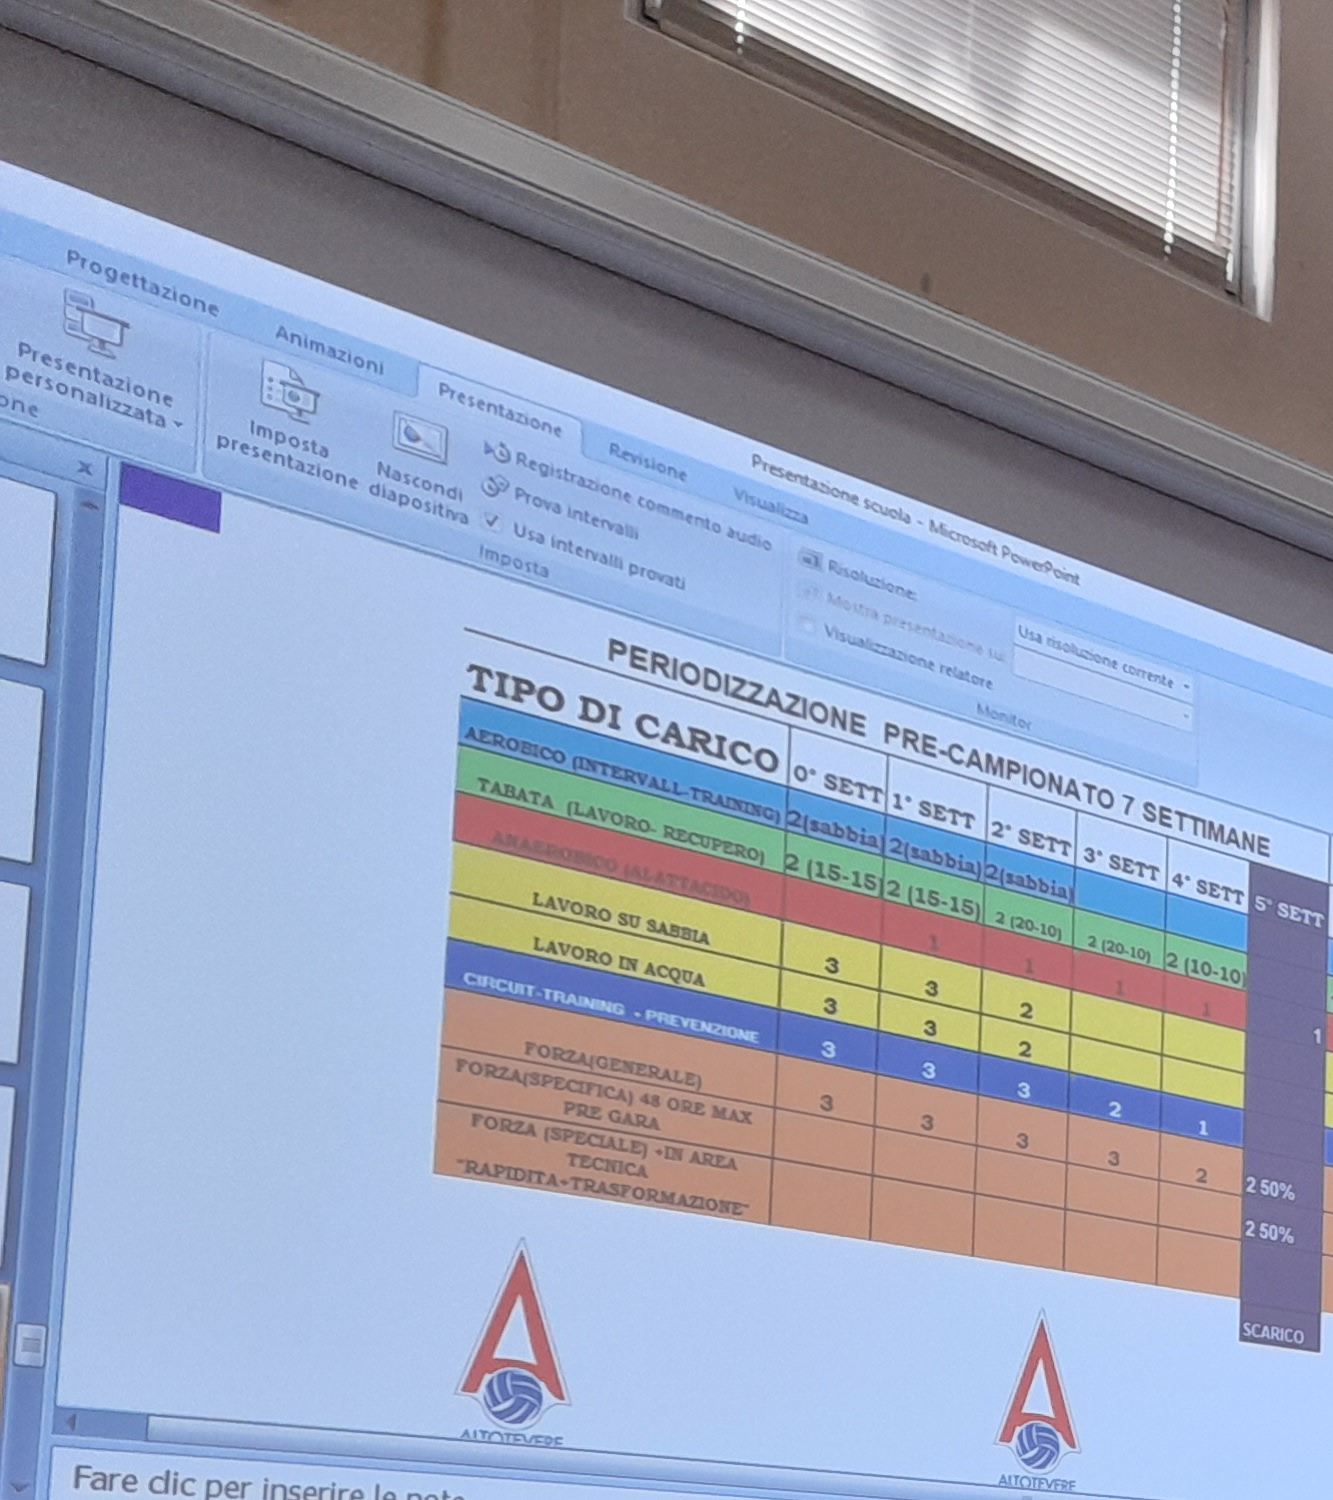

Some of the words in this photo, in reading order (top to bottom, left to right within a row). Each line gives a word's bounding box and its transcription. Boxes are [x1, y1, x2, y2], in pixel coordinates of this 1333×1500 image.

[67, 249, 220, 317] Progettazione
[276, 325, 385, 377] Animazioni
[18, 341, 173, 408] Presentazione
[5, 365, 166, 429] personalizzata
[439, 381, 564, 440] Presentazione
[251, 420, 328, 460] Imposta
[216, 433, 359, 492] presentazione
[609, 442, 688, 483] Revisione
[377, 460, 464, 503] Nascondi
[369, 480, 470, 527] diapositiva
[515, 487, 562, 514] Prova
[567, 502, 639, 540] intervalli
[516, 451, 631, 507] Registrazione
[638, 496, 722, 534] commento
[727, 524, 773, 552] audio
[734, 487, 809, 525] Visualizza
[751, 452, 860, 507] Presentazione
[864, 495, 912, 526] scuola
[929, 518, 999, 557] Microsoft
[1001, 545, 1081, 587] PowerPoint
[479, 544, 550, 580] Imposta
[515, 522, 545, 544] Usa
[551, 532, 623, 570] intervalli
[628, 562, 686, 592] provati
[825, 625, 935, 673] Visualizzazione
[940, 663, 994, 691] relatore
[1018, 624, 1043, 646] Usa
[1047, 635, 1118, 671] risoluzione
[1123, 662, 1174, 690] corrente
[467, 663, 565, 713] TIPO
[578, 695, 621, 730] DI
[635, 714, 779, 774] CARICO
[977, 702, 1033, 731] Monitor
[464, 726, 566, 765] AEROBICO
[607, 637, 866, 738] PERIODIZZAZIONE
[884, 721, 1115, 811] PRE-CAMPIONATO
[1121, 795, 1135, 815] 7
[1143, 801, 1271, 858] SETTIMANE
[824, 774, 883, 804] SETT
[478, 777, 555, 810] TABATA
[664, 825, 766, 866] RECUPERO)
[786, 810, 886, 850] 2(sabbia)
[918, 800, 975, 830] SETT
[1018, 828, 1072, 857] SETT
[785, 854, 799, 871] 2
[807, 860, 884, 893] (15-15)
[889, 838, 983, 883] 2(sabbia)
[1109, 854, 1160, 882] SETT
[986, 864, 1075, 903] 2(sabbia)
[1196, 880, 1245, 906] SETT
[887, 881, 901, 897] 2
[908, 888, 981, 923] (15-15)
[1276, 902, 1325, 929] SETT
[532, 892, 611, 923] LAVORO
[617, 912, 640, 929] SU
[646, 920, 711, 946] SABBIA
[995, 911, 1005, 924] 2
[1011, 916, 1062, 942] (20-10)
[533, 937, 612, 967] LAVORO
[619, 955, 638, 972] IN
[644, 963, 706, 988] ACQUA
[825, 957, 839, 974] 3
[1087, 936, 1097, 948] 2
[1102, 940, 1151, 964] (20-10)
[1167, 953, 1178, 968] 2
[1184, 957, 1246, 985] (10-10)
[925, 980, 939, 997] 3
[463, 972, 625, 1017] CIRCUIT-TRAINING
[645, 1009, 760, 1044] PREVENZIONE
[823, 997, 838, 1014] 3
[1019, 1002, 1033, 1019] 2
[923, 1020, 937, 1036] 3
[1313, 1028, 1321, 1044] 1
[821, 1041, 836, 1058] 3
[1018, 1041, 1032, 1058] 2
[921, 1063, 936, 1080] 3
[820, 1095, 834, 1112] 3
[1016, 1082, 1031, 1099] 3
[564, 1101, 602, 1120] PRE
[609, 1110, 661, 1132] GARA
[667, 1097, 706, 1116] ORE
[713, 1105, 753, 1126] MAX
[921, 1114, 934, 1131] 3
[1109, 1101, 1122, 1118] 2
[471, 1113, 537, 1138] FORZA
[544, 1121, 648, 1159] (SPECIALE)
[690, 1150, 738, 1172] AREA
[1016, 1133, 1029, 1149] 3
[1199, 1121, 1208, 1136] 1
[567, 1152, 648, 1179] TECNICA
[1108, 1151, 1120, 1167] 3
[1195, 1168, 1208, 1184] 2
[1246, 1177, 1257, 1193] 2
[1260, 1180, 1295, 1201] 50%
[1245, 1221, 1256, 1237] 2
[1259, 1224, 1294, 1245] 50%
[1242, 1322, 1305, 1345] SCARICO
[73, 1464, 139, 1497] Fare
[148, 1468, 196, 1498] clic
